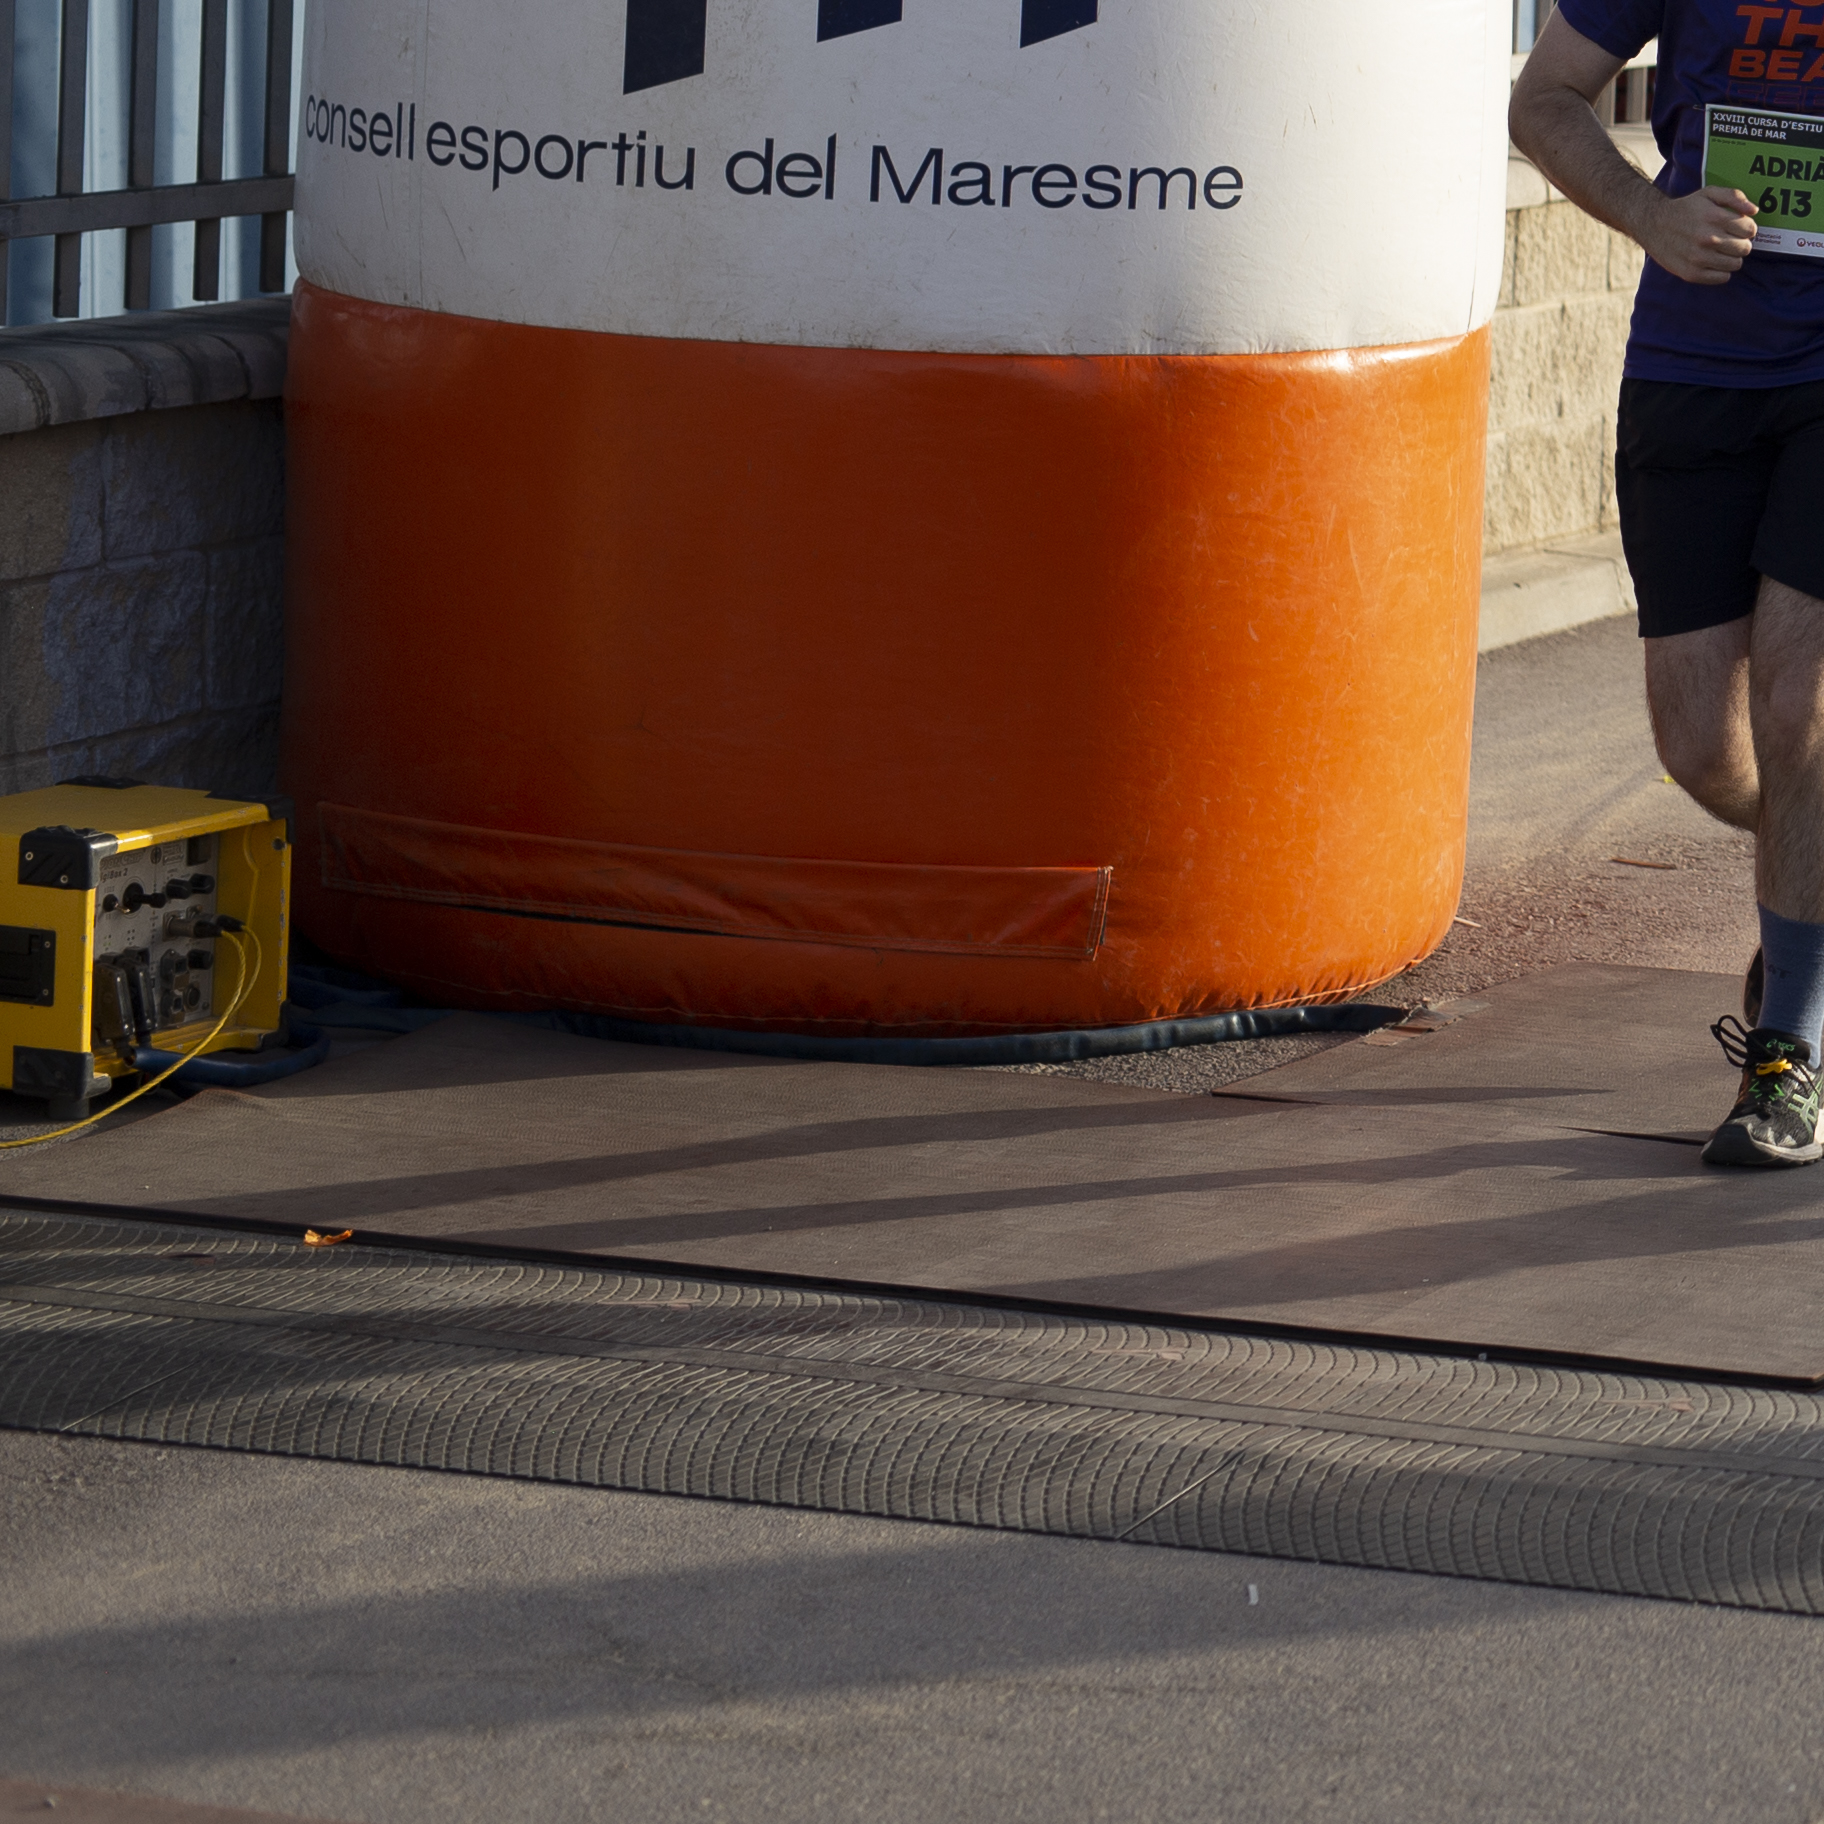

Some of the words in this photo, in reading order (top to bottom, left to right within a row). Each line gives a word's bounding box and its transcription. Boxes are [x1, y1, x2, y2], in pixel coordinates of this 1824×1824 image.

[1712, 123, 1749, 136] PREMIÀ
[1750, 128, 1763, 137] DE
[1765, 130, 1787, 140] MAR
[1713, 112, 1745, 124] XXVIII
[1747, 116, 1778, 128] CURSA
[1781, 120, 1823, 133] D'ESTIU
[306, 94, 416, 161] consell
[426, 119, 696, 192] esportiu
[725, 132, 837, 201] del
[870, 144, 1244, 211] Maresme
[1758, 186, 1812, 218] 613
